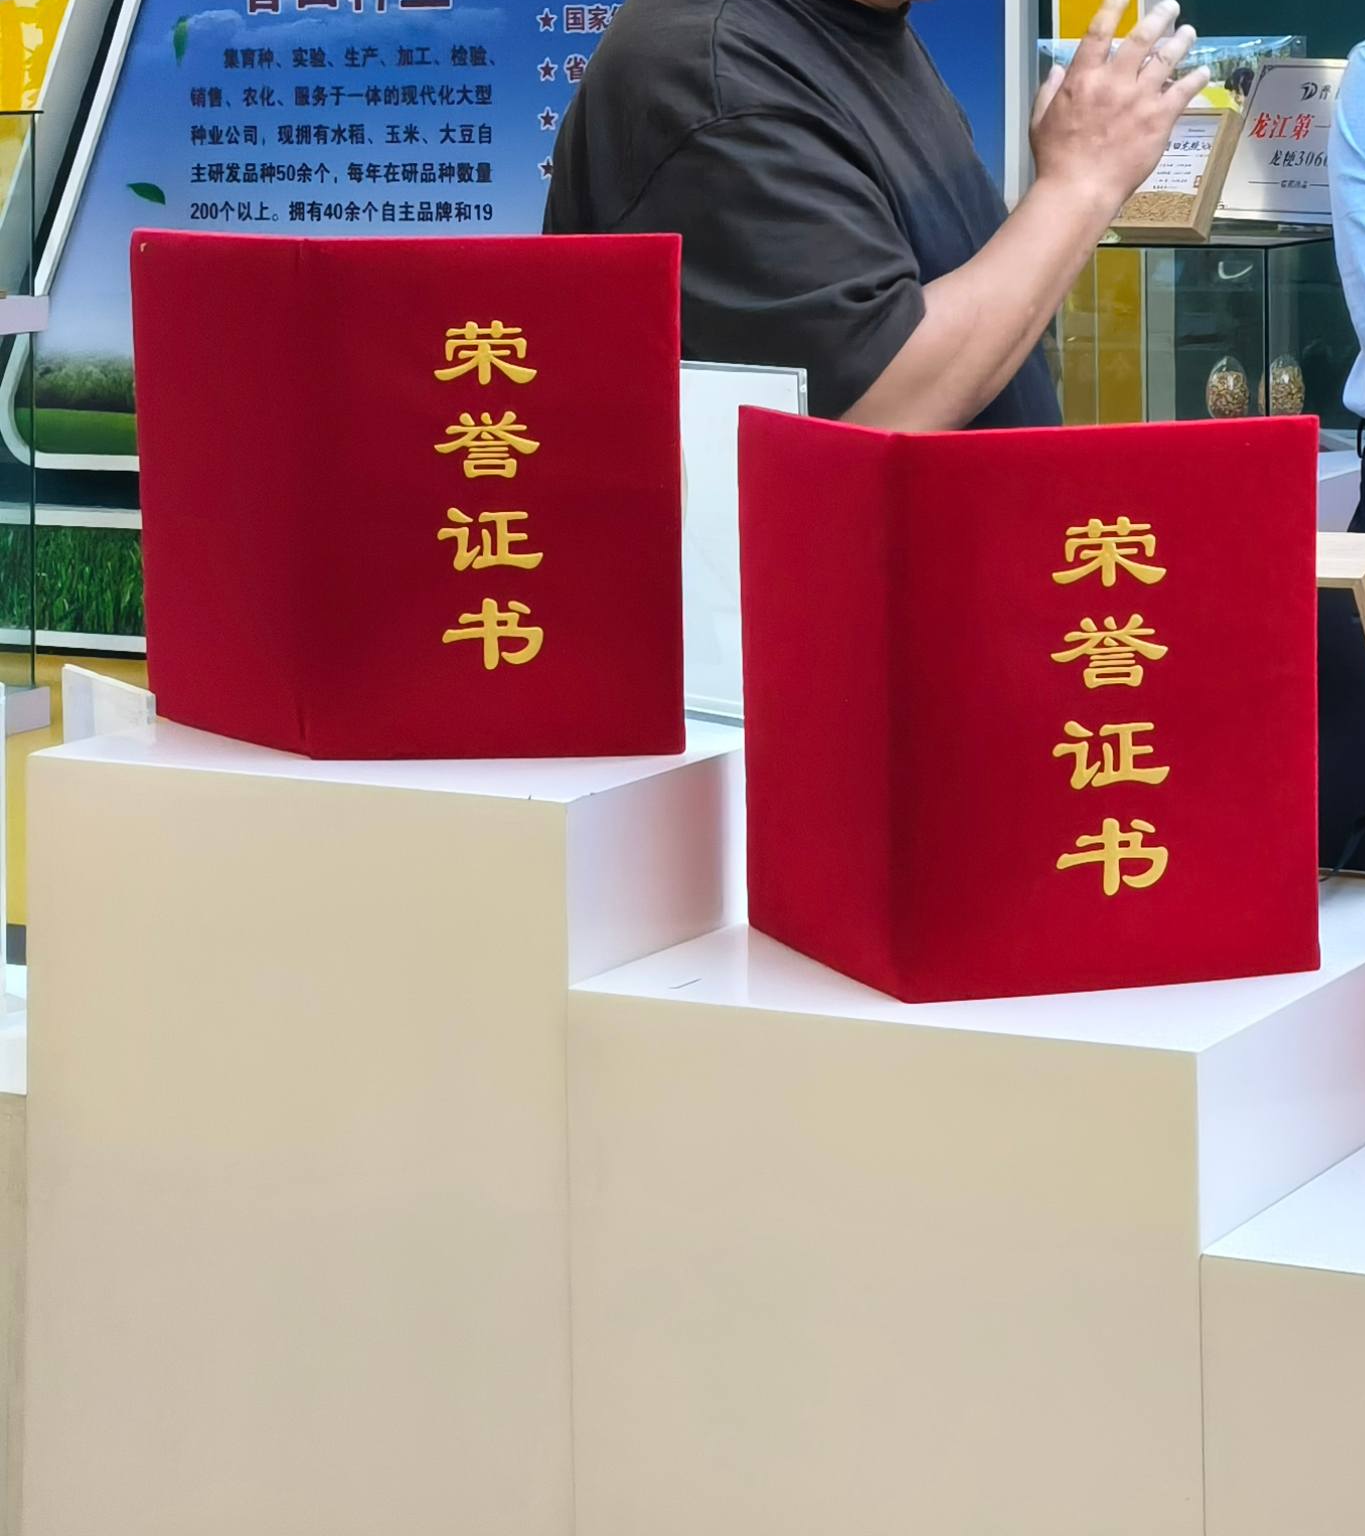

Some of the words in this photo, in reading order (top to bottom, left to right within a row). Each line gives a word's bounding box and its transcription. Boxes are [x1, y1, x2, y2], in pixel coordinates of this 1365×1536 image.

[190, 162, 492, 184] 主研发品种50余个，每年在研品种数量
[190, 200, 493, 223] 200个以上。拥有40余个自主品牌和19
[434, 320, 544, 670] 荣誉证书
[1050, 516, 1170, 896] 荣誉证书
